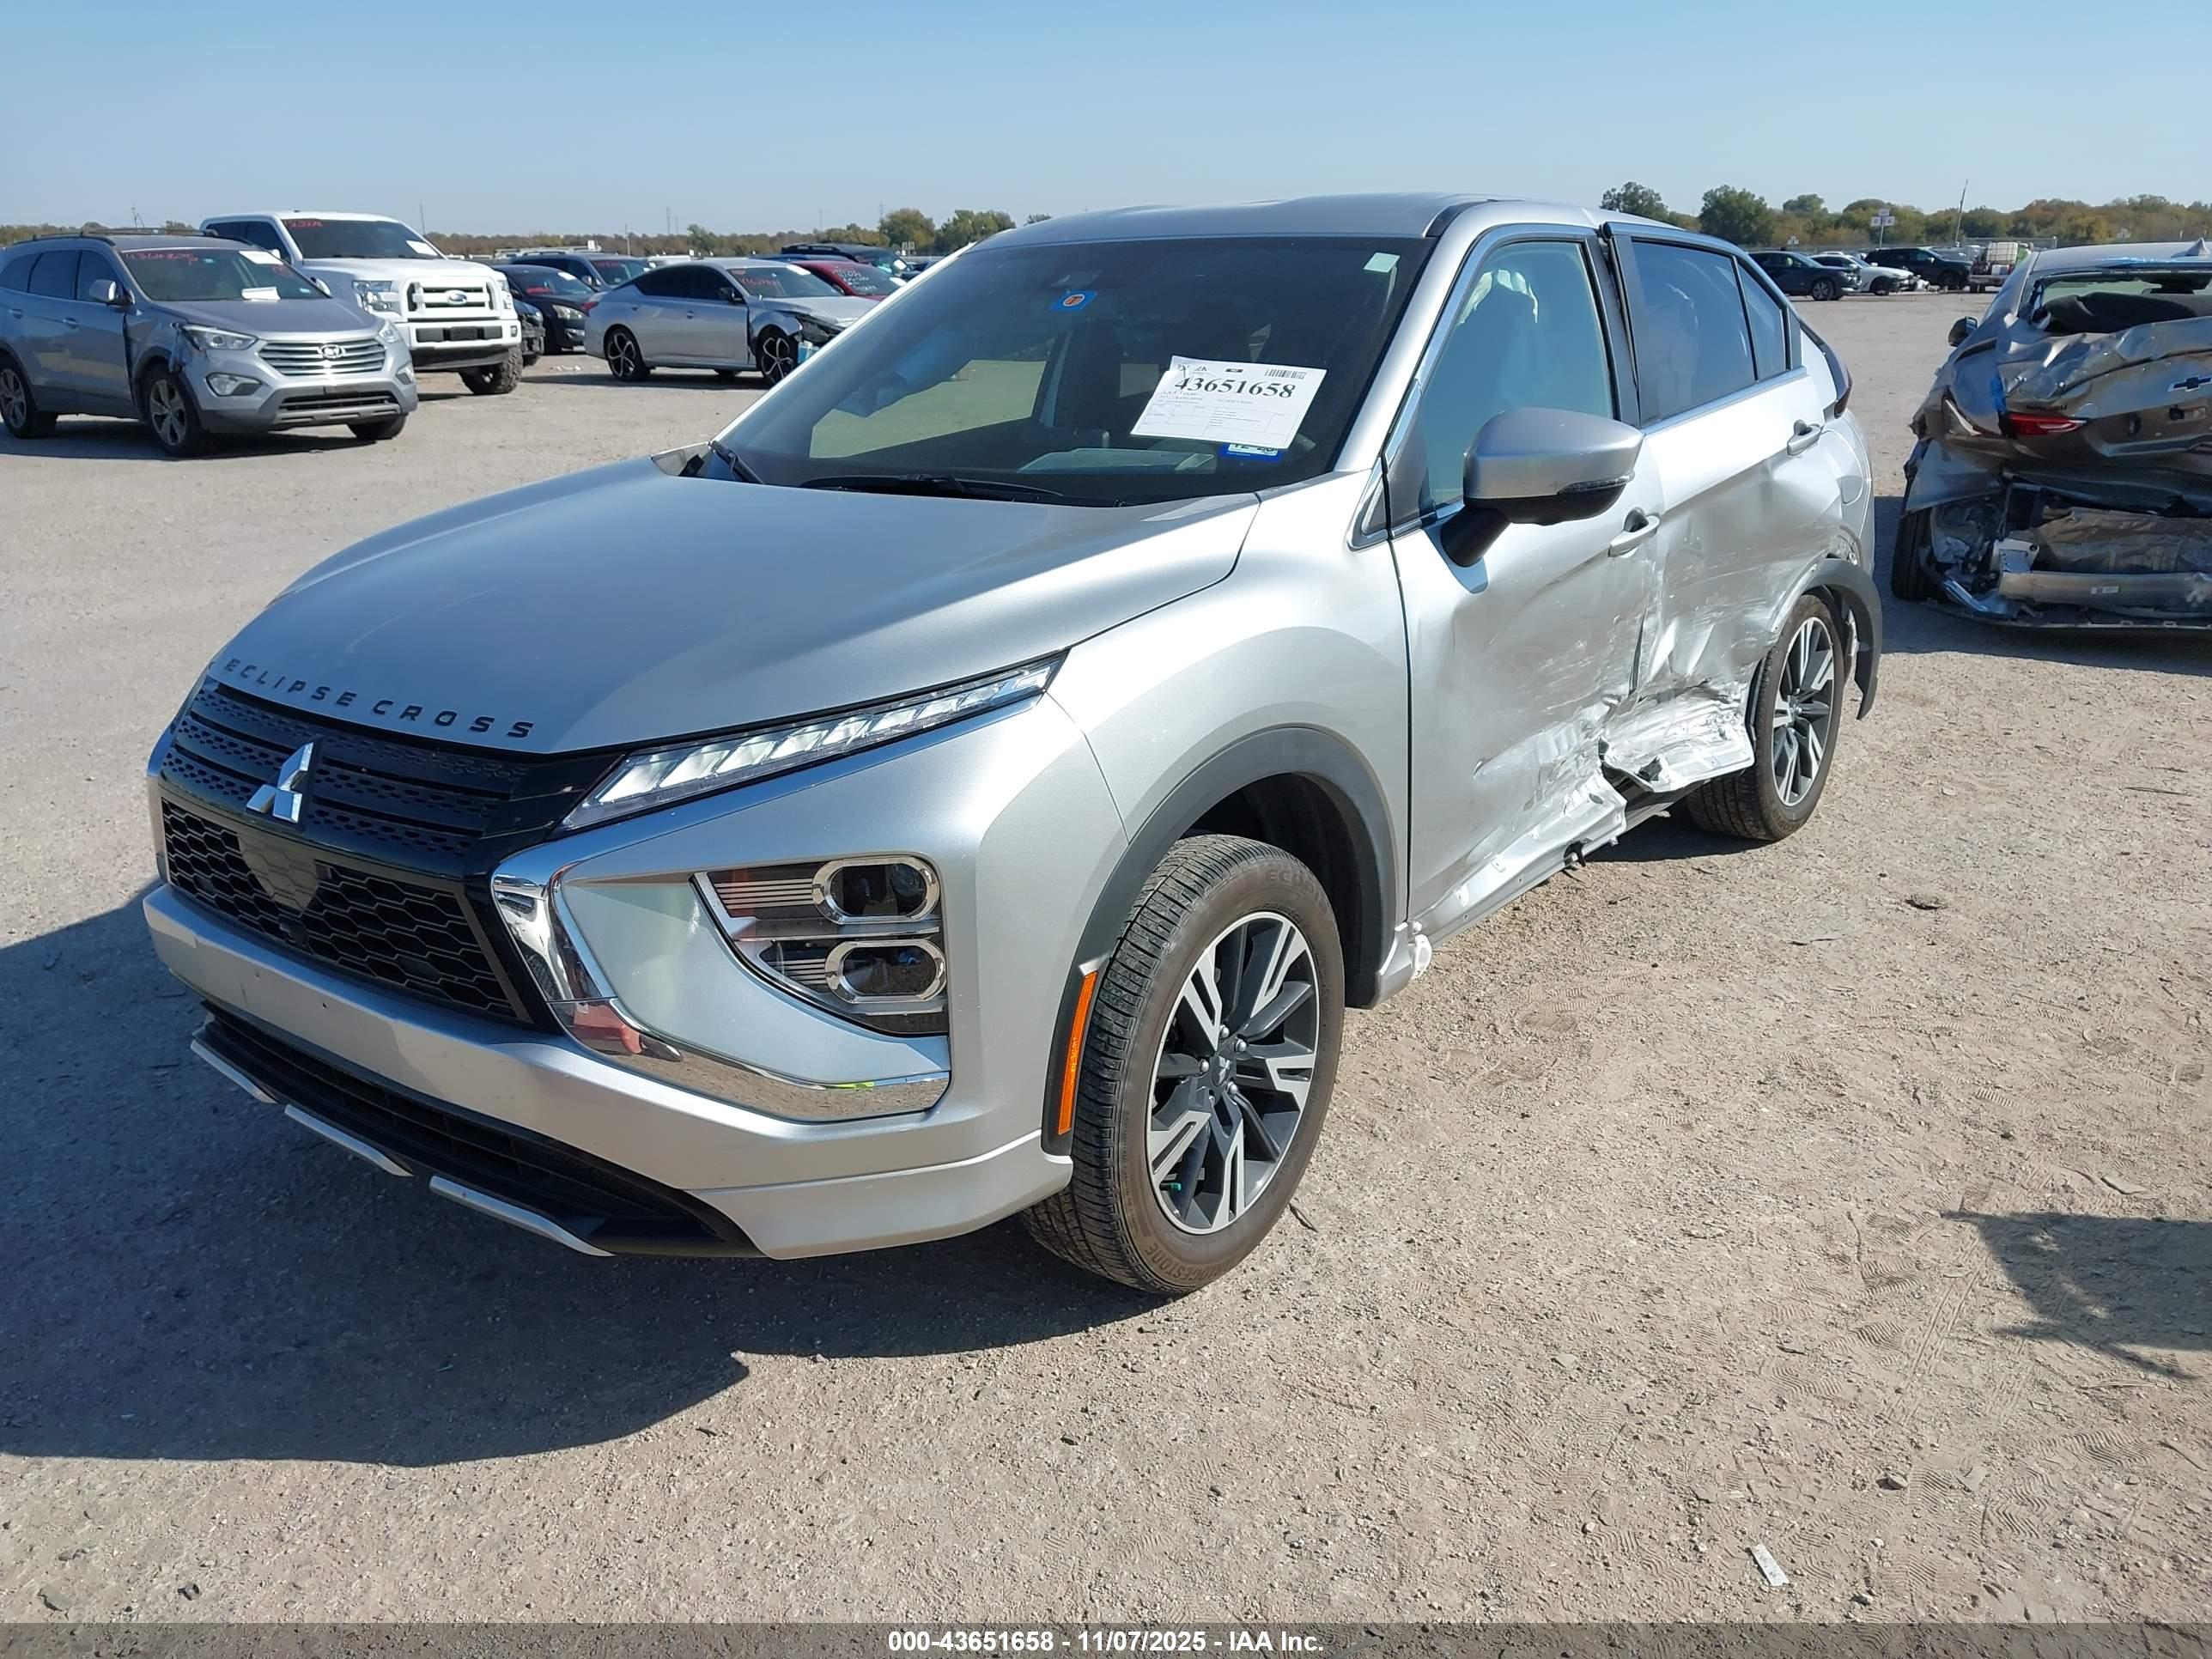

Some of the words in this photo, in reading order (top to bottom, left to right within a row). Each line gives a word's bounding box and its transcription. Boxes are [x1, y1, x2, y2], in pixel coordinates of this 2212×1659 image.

[1174, 377, 1297, 399] 43651658
[223, 658, 357, 708] ECLIPSE
[372, 699, 534, 738] CROSS
